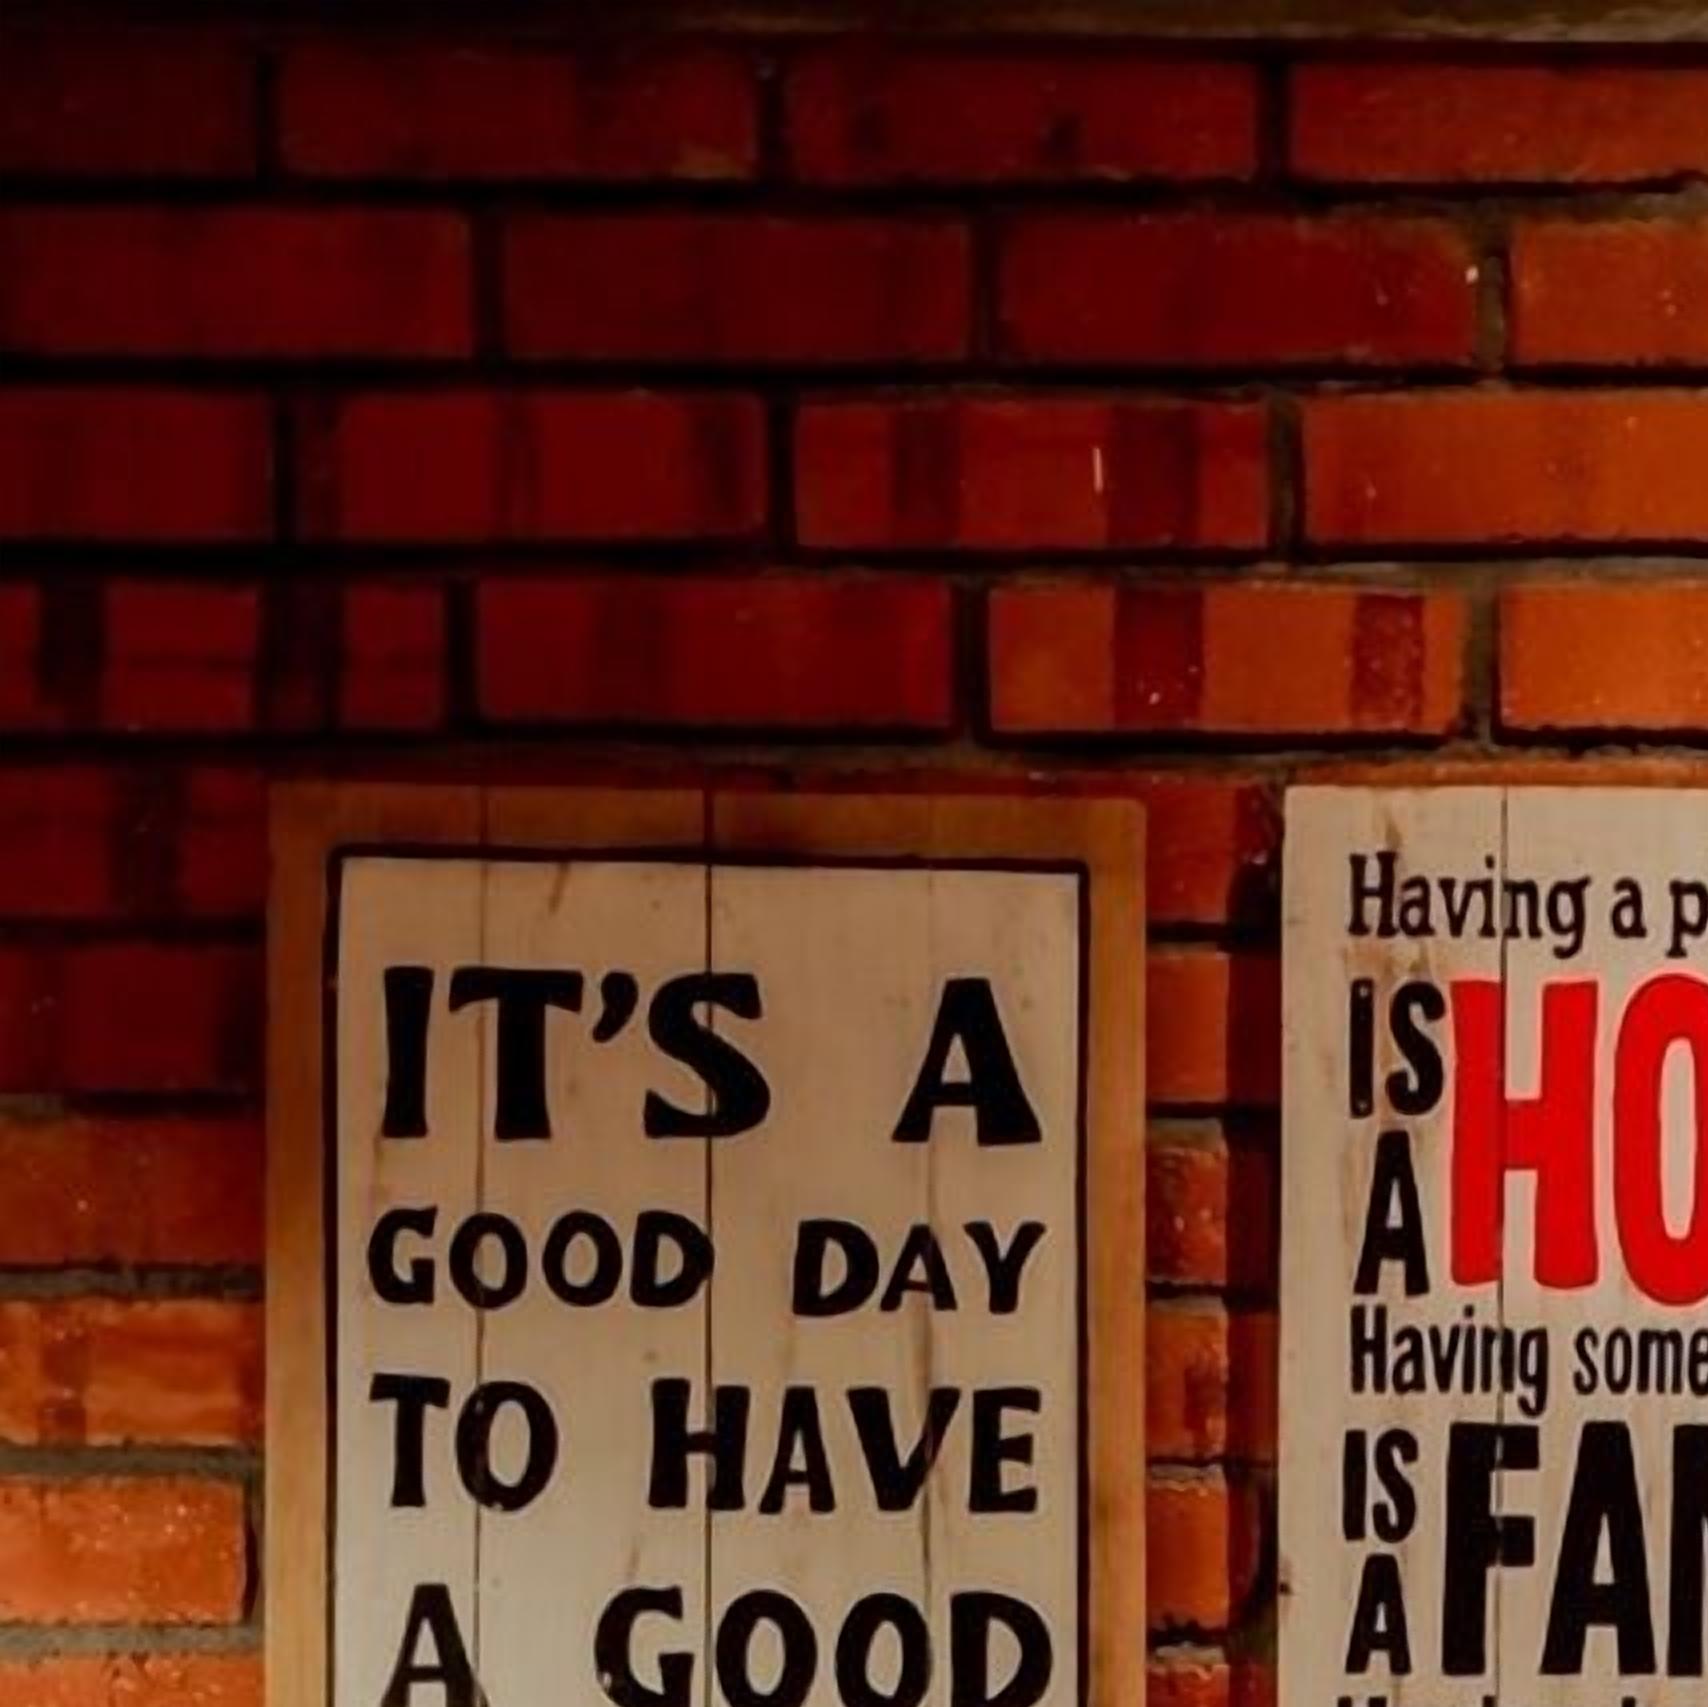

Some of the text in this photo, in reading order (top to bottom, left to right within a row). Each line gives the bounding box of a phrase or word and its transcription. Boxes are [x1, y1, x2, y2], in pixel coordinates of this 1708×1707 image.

[1347, 853, 1592, 956] Having
[1611, 876, 1648, 935] a
[382, 966, 1042, 1146] IT'S A
[1347, 977, 1447, 1120] IS
[367, 1206, 1045, 1318] GOOD DAY
[1353, 1129, 1431, 1298] A
[1349, 1305, 1551, 1416] Having
[369, 1373, 1041, 1514] TO HAVE
[1342, 1428, 1418, 1544] IS
[1345, 1553, 1413, 1675] A
